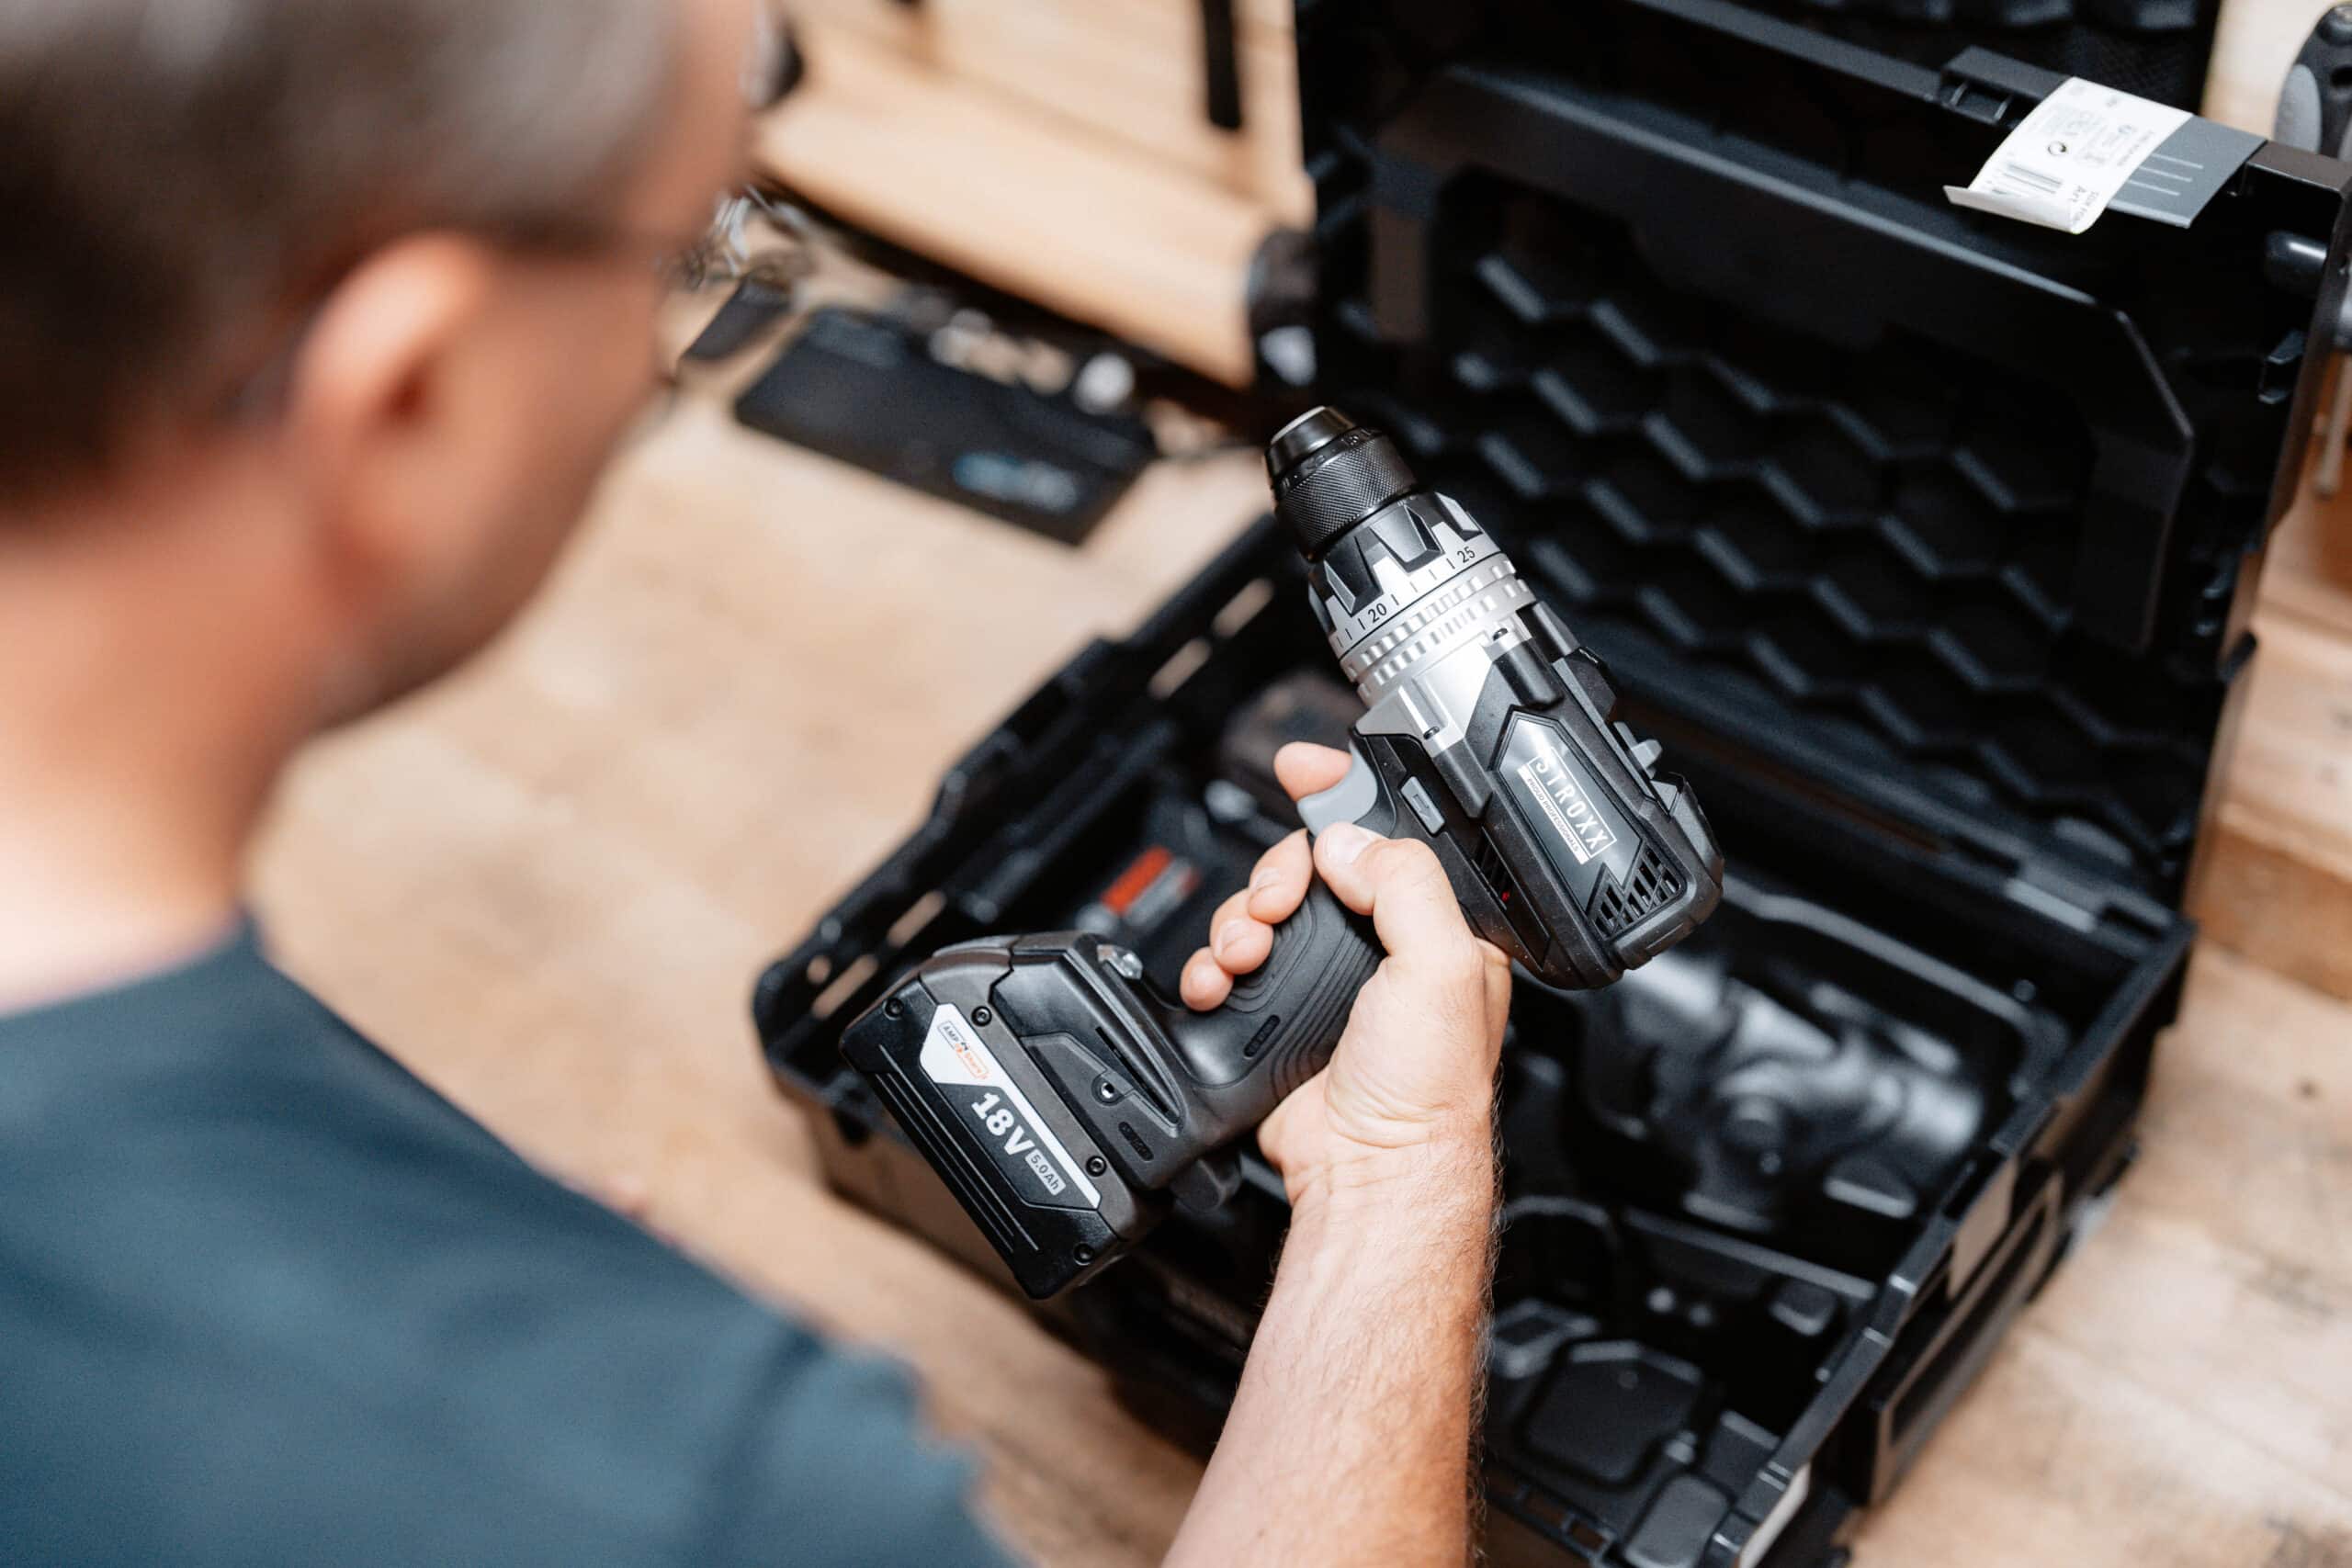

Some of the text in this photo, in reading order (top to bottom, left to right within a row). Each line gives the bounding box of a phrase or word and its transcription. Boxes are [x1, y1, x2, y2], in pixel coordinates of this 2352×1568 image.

[1457, 546, 1476, 564] 25
[1368, 603, 1387, 623] 20
[1526, 777, 1578, 852] PROUD PROFESSIONALS
[1535, 756, 1608, 850] STROXX
[944, 1026, 959, 1041] AMP
[971, 1092, 1059, 1190] 18V 5.0Ah
